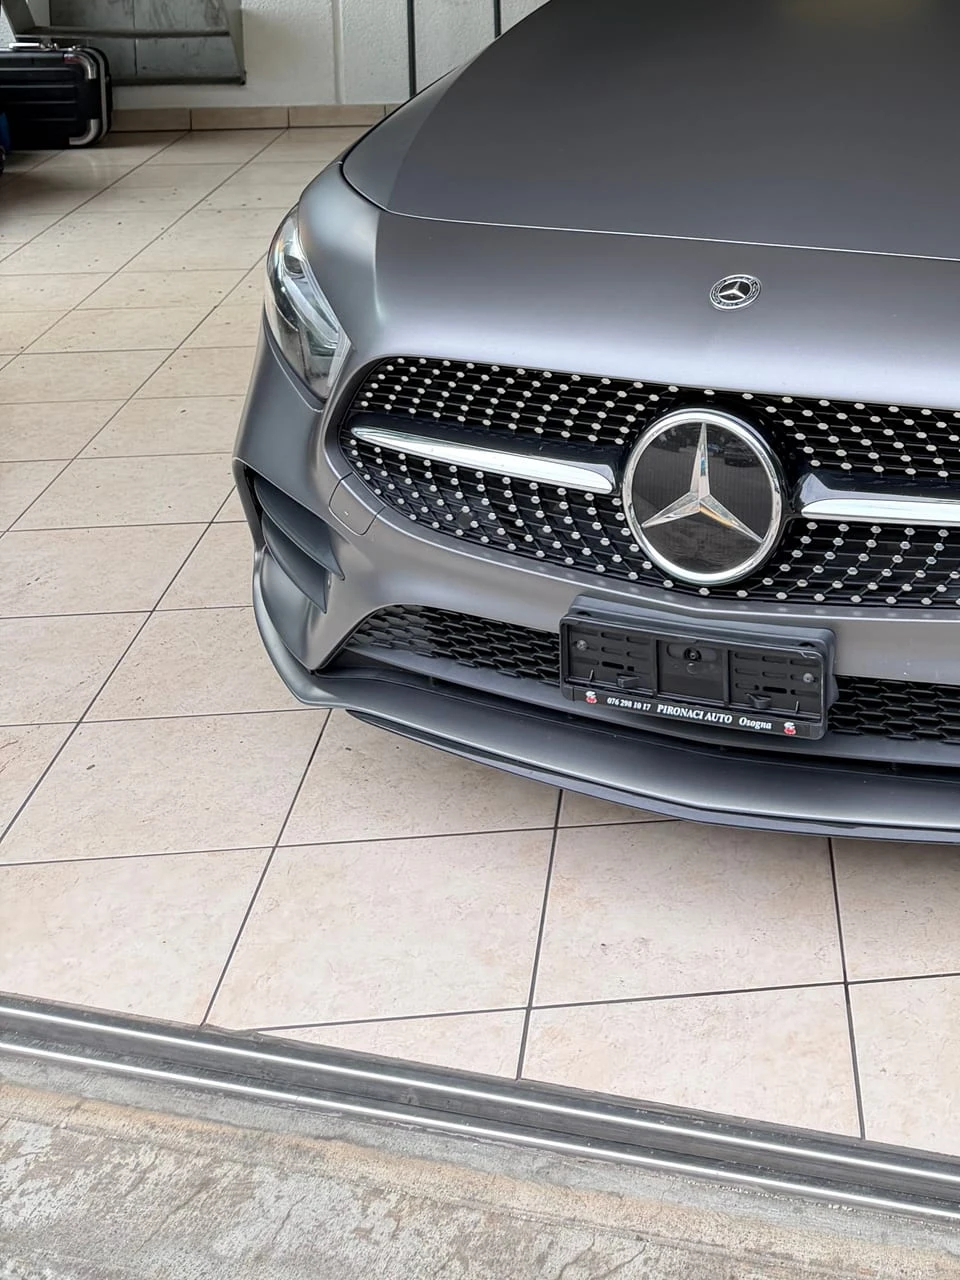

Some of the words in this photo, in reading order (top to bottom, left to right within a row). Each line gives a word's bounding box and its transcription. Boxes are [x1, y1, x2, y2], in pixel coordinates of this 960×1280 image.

[607, 697, 620, 706] 076
[642, 703, 652, 711] 17
[656, 704, 704, 719] PIRONACI
[704, 712, 733, 724] AUTO
[738, 717, 772, 730] Osogna
